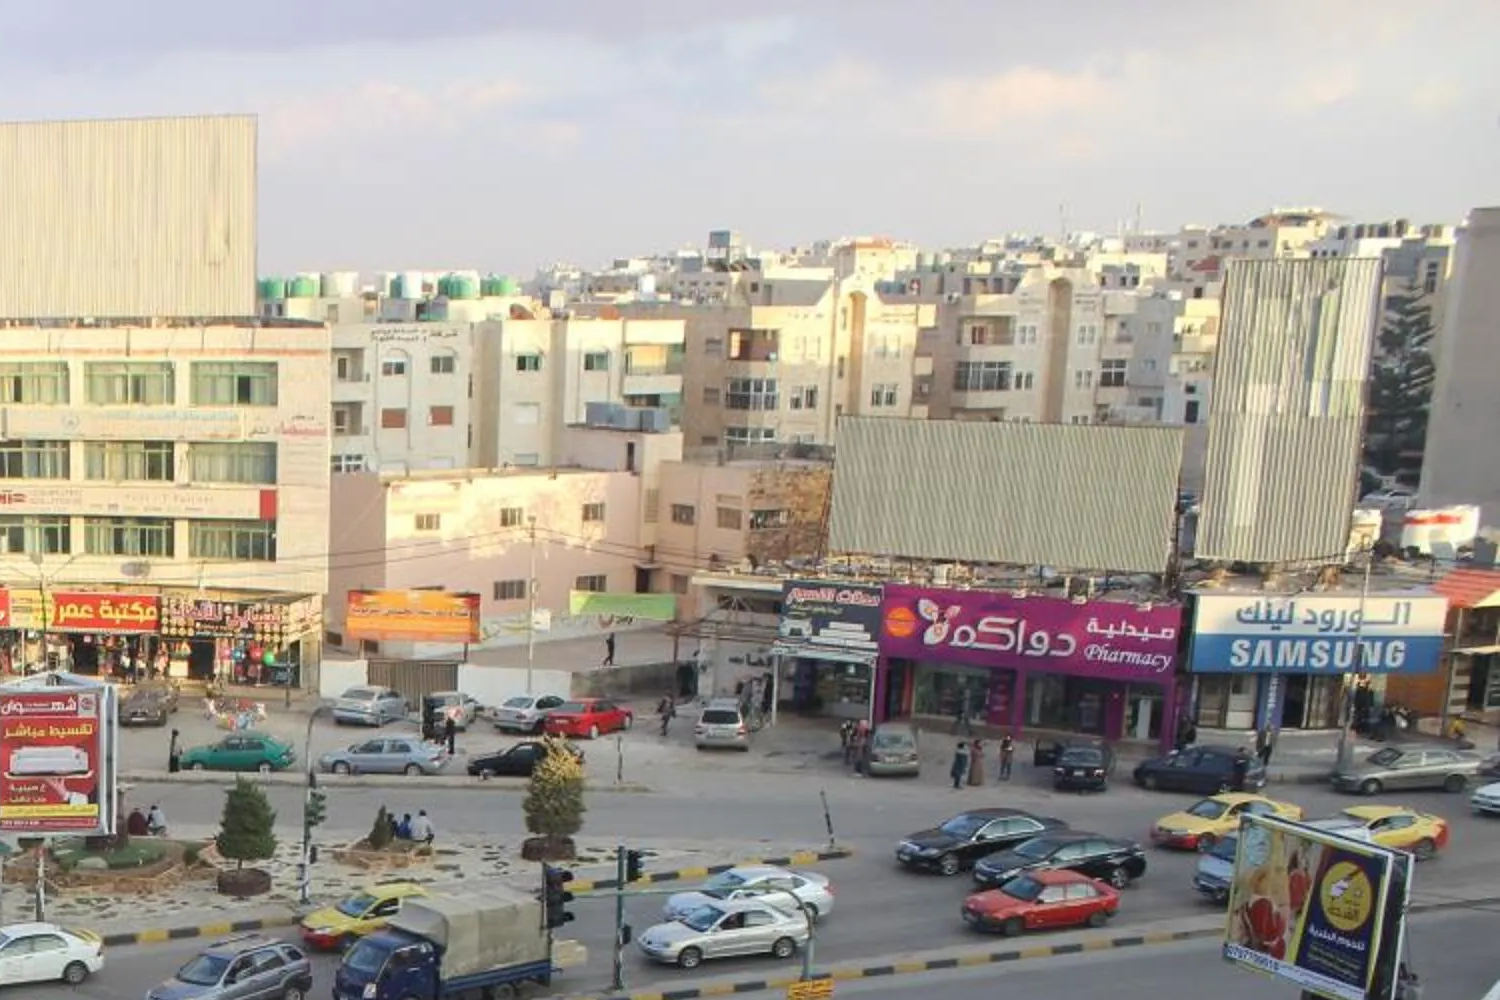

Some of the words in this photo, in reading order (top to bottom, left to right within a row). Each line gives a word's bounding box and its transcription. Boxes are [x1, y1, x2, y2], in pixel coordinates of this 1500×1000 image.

[59, 601, 93, 622] عمر
[100, 599, 158, 625] مكتبة
[1236, 602, 1295, 631] لينك
[1303, 602, 1412, 633] الورود
[1086, 616, 1175, 641] صيدلية
[1084, 644, 1173, 672] Pharmacy
[1230, 639, 1405, 667] SAMSUNG
[4, 722, 45, 739] مباشر
[50, 724, 93, 739] تقسيط
